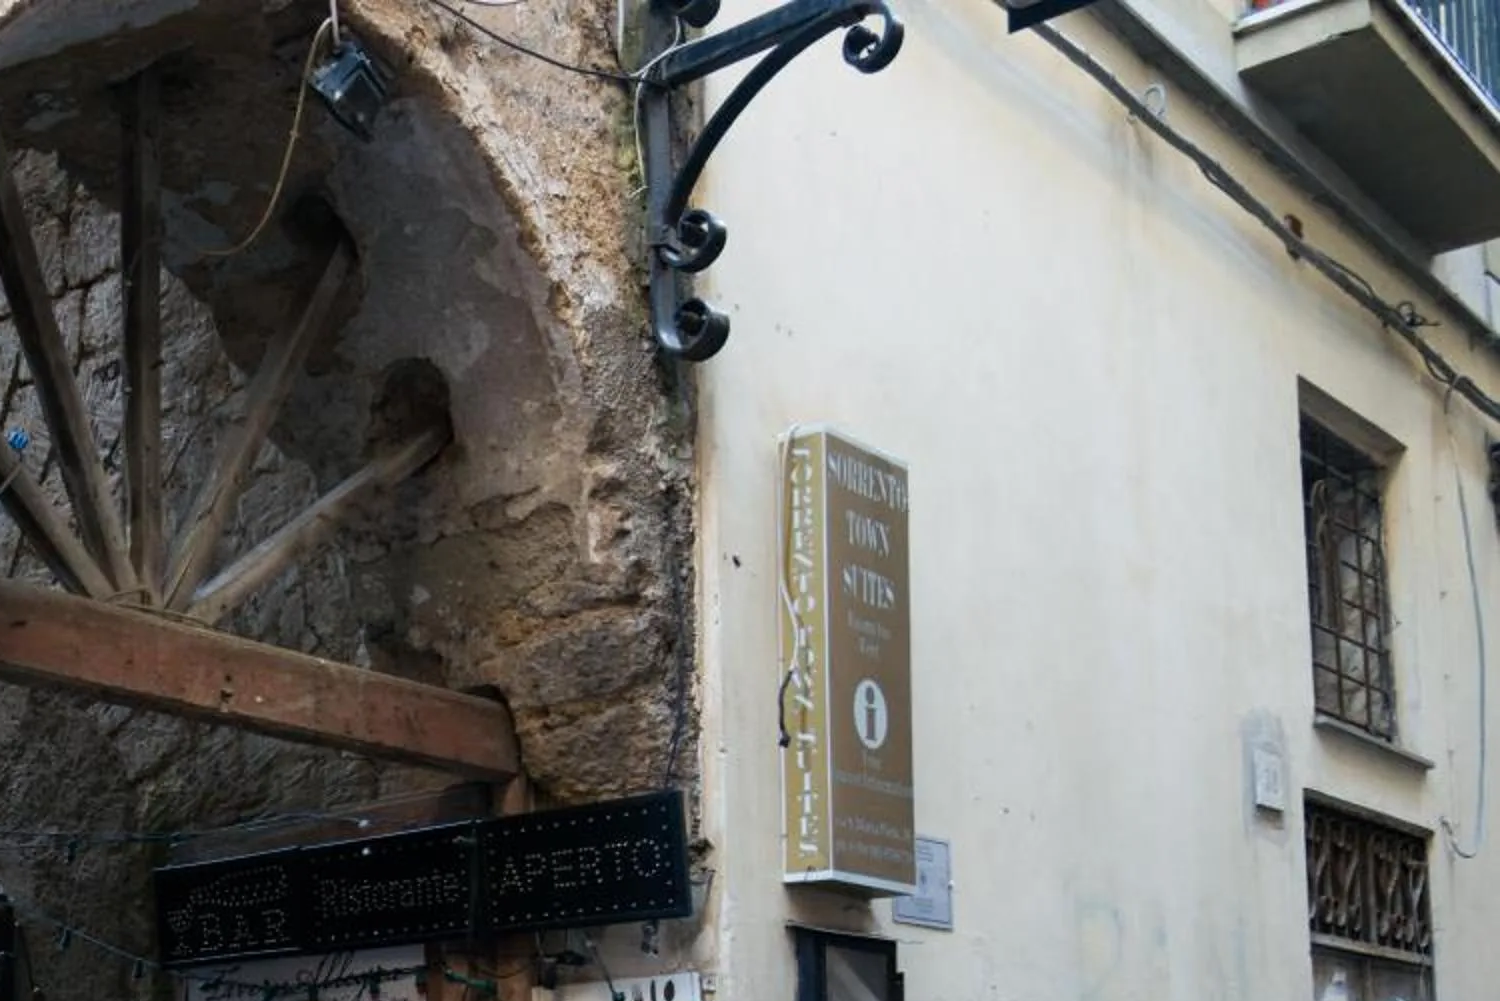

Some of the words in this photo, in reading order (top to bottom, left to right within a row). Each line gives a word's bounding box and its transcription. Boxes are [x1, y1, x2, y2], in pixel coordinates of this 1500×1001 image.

[826, 451, 909, 513] SORRENTO
[845, 508, 891, 558] TOWN
[842, 563, 897, 609] SUITES
[499, 836, 662, 896] APERTO
[196, 905, 292, 952] BAR
